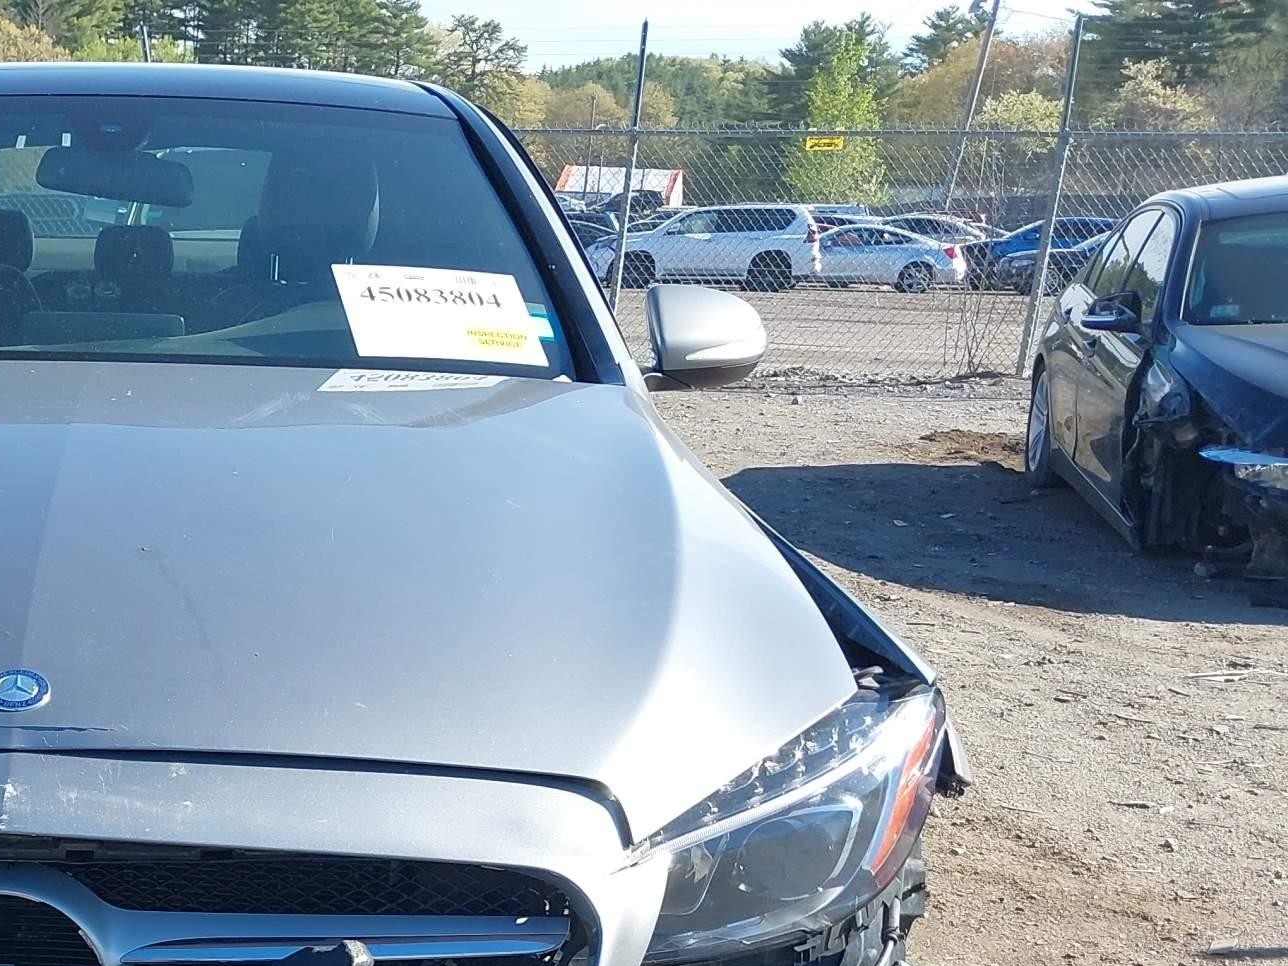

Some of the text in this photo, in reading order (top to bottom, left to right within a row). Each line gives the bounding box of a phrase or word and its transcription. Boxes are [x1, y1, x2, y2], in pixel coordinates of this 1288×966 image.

[360, 286, 501, 308] 45083804
[467, 329, 528, 341] INSPECTION
[478, 338, 523, 348] SERVICE
